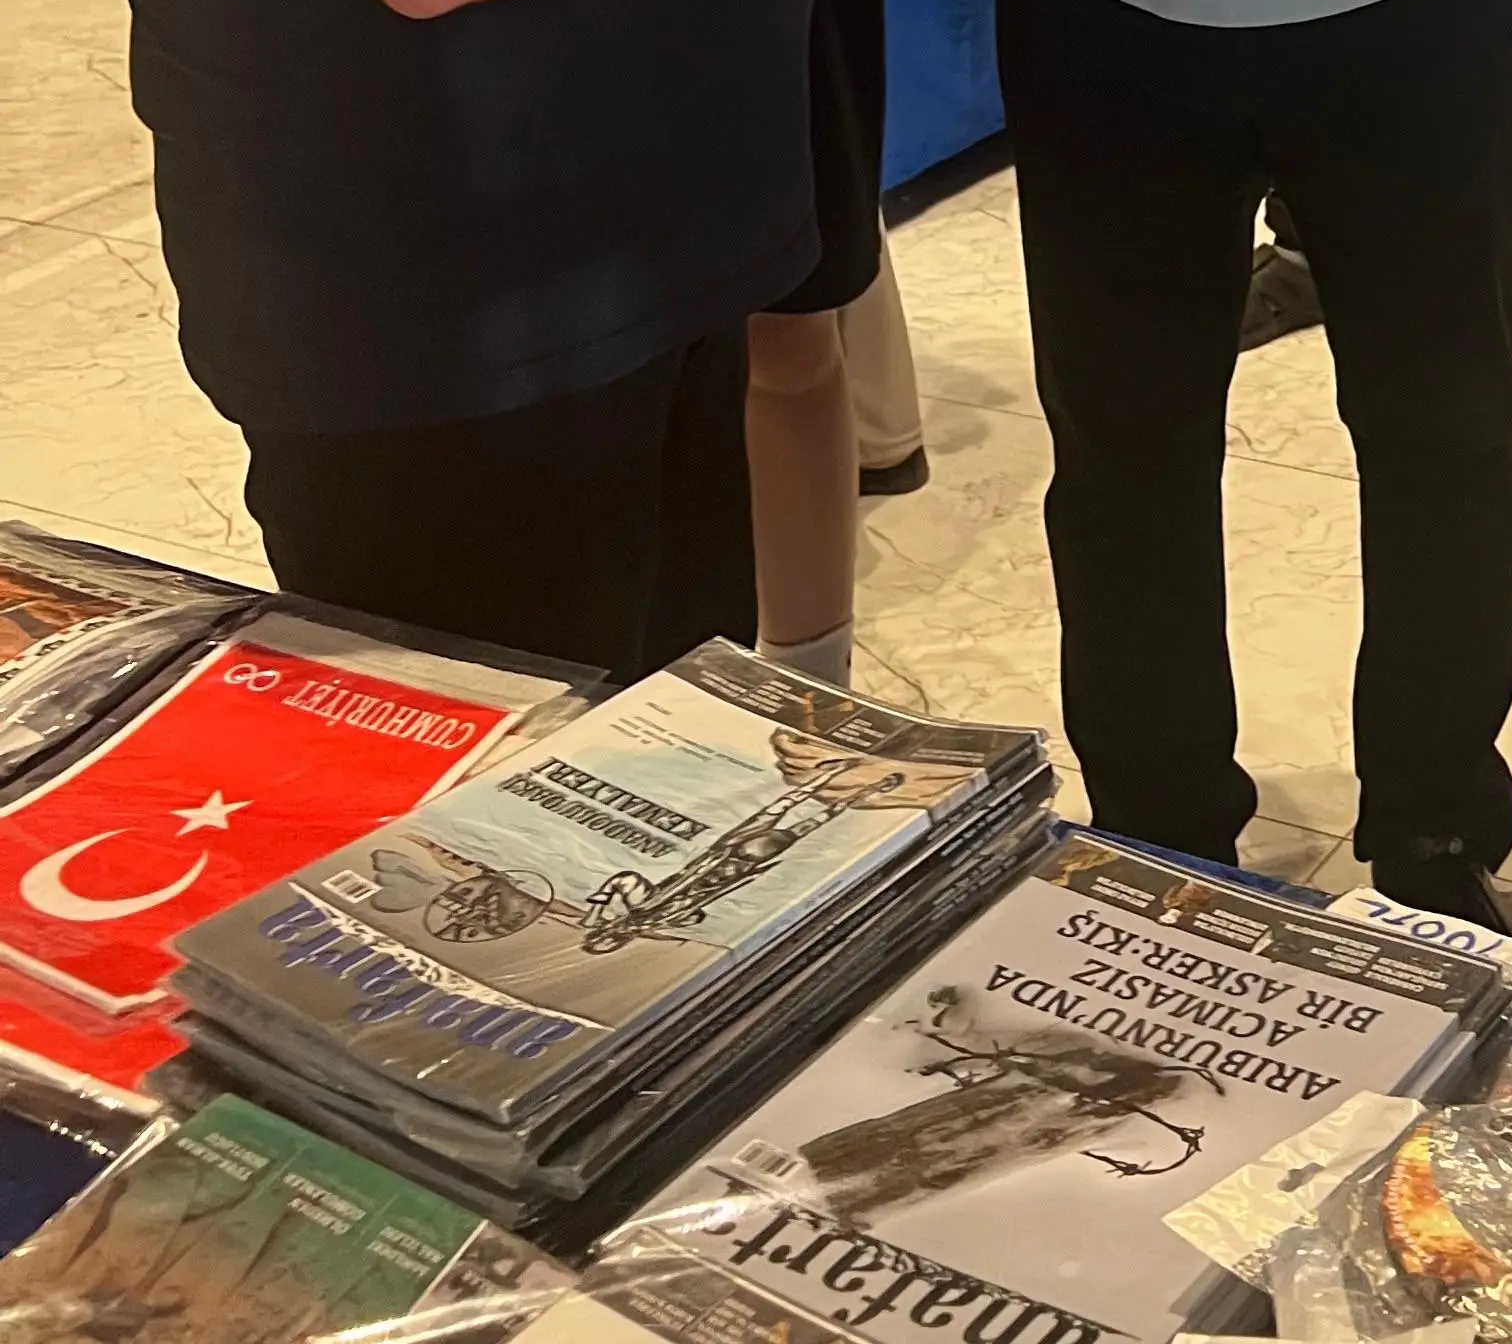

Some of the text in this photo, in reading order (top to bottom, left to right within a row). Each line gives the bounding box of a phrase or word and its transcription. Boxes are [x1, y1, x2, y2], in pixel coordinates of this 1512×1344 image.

[281, 677, 477, 750] CUMHURİYET
[529, 755, 712, 841] KEMALYERİ
[1057, 909, 1293, 1003] ASKER:KIŞ
[986, 964, 1342, 1100] ARIBURNU'NDA
[1069, 957, 1306, 1048] ACIMASIZ
[1296, 989, 1385, 1034] BİR
